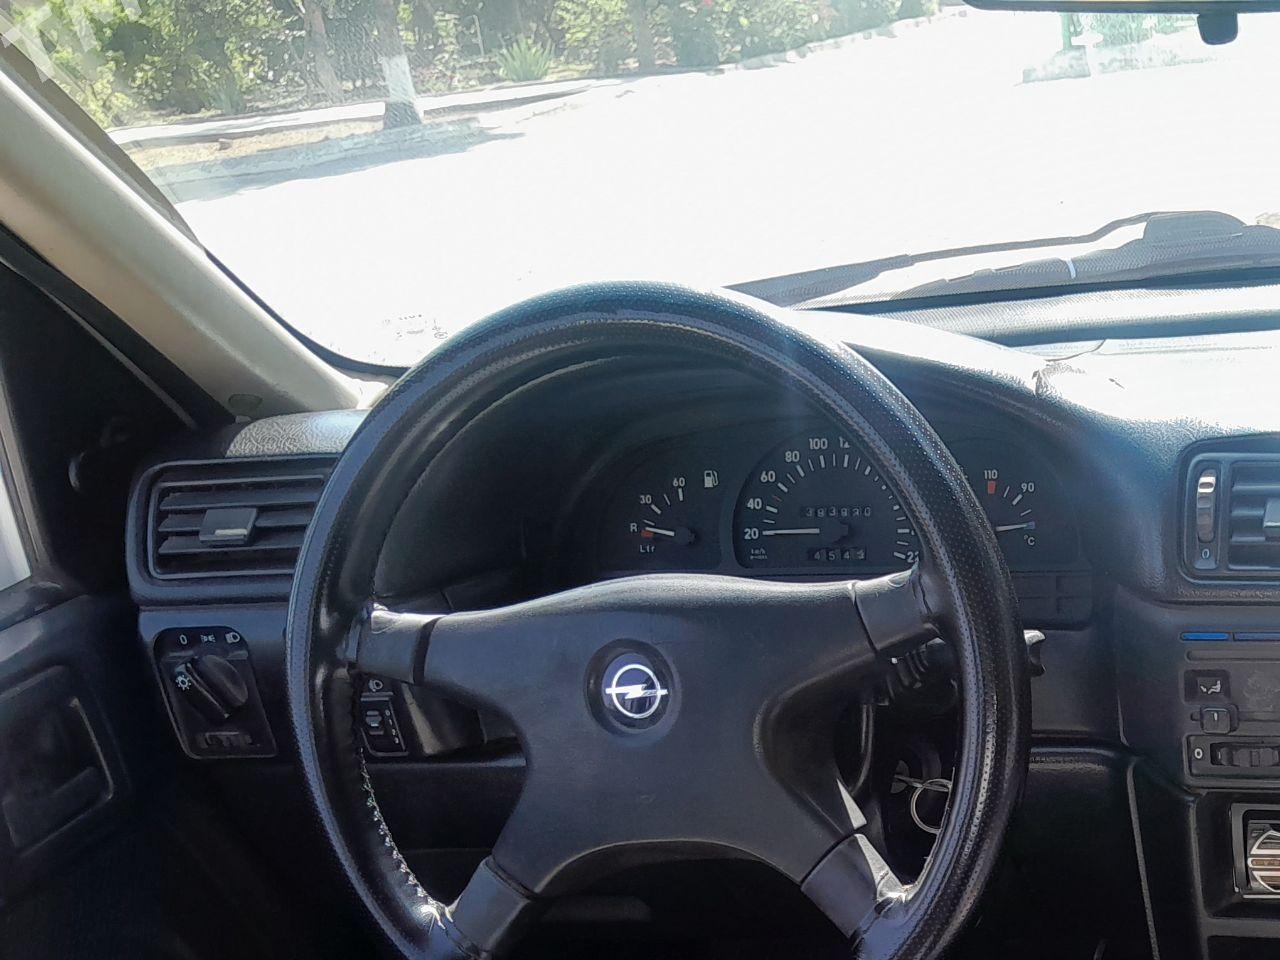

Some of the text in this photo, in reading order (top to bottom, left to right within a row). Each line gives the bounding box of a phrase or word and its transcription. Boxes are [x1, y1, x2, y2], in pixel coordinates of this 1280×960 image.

[808, 438, 829, 450] 100
[784, 451, 801, 463] 80
[759, 470, 777, 483] 60
[983, 469, 998, 480] 110
[672, 476, 686, 488] 60
[1020, 482, 1036, 493] 90
[639, 494, 653, 505] 30
[746, 497, 763, 510] 40
[629, 523, 638, 533] R
[743, 527, 760, 540] 20
